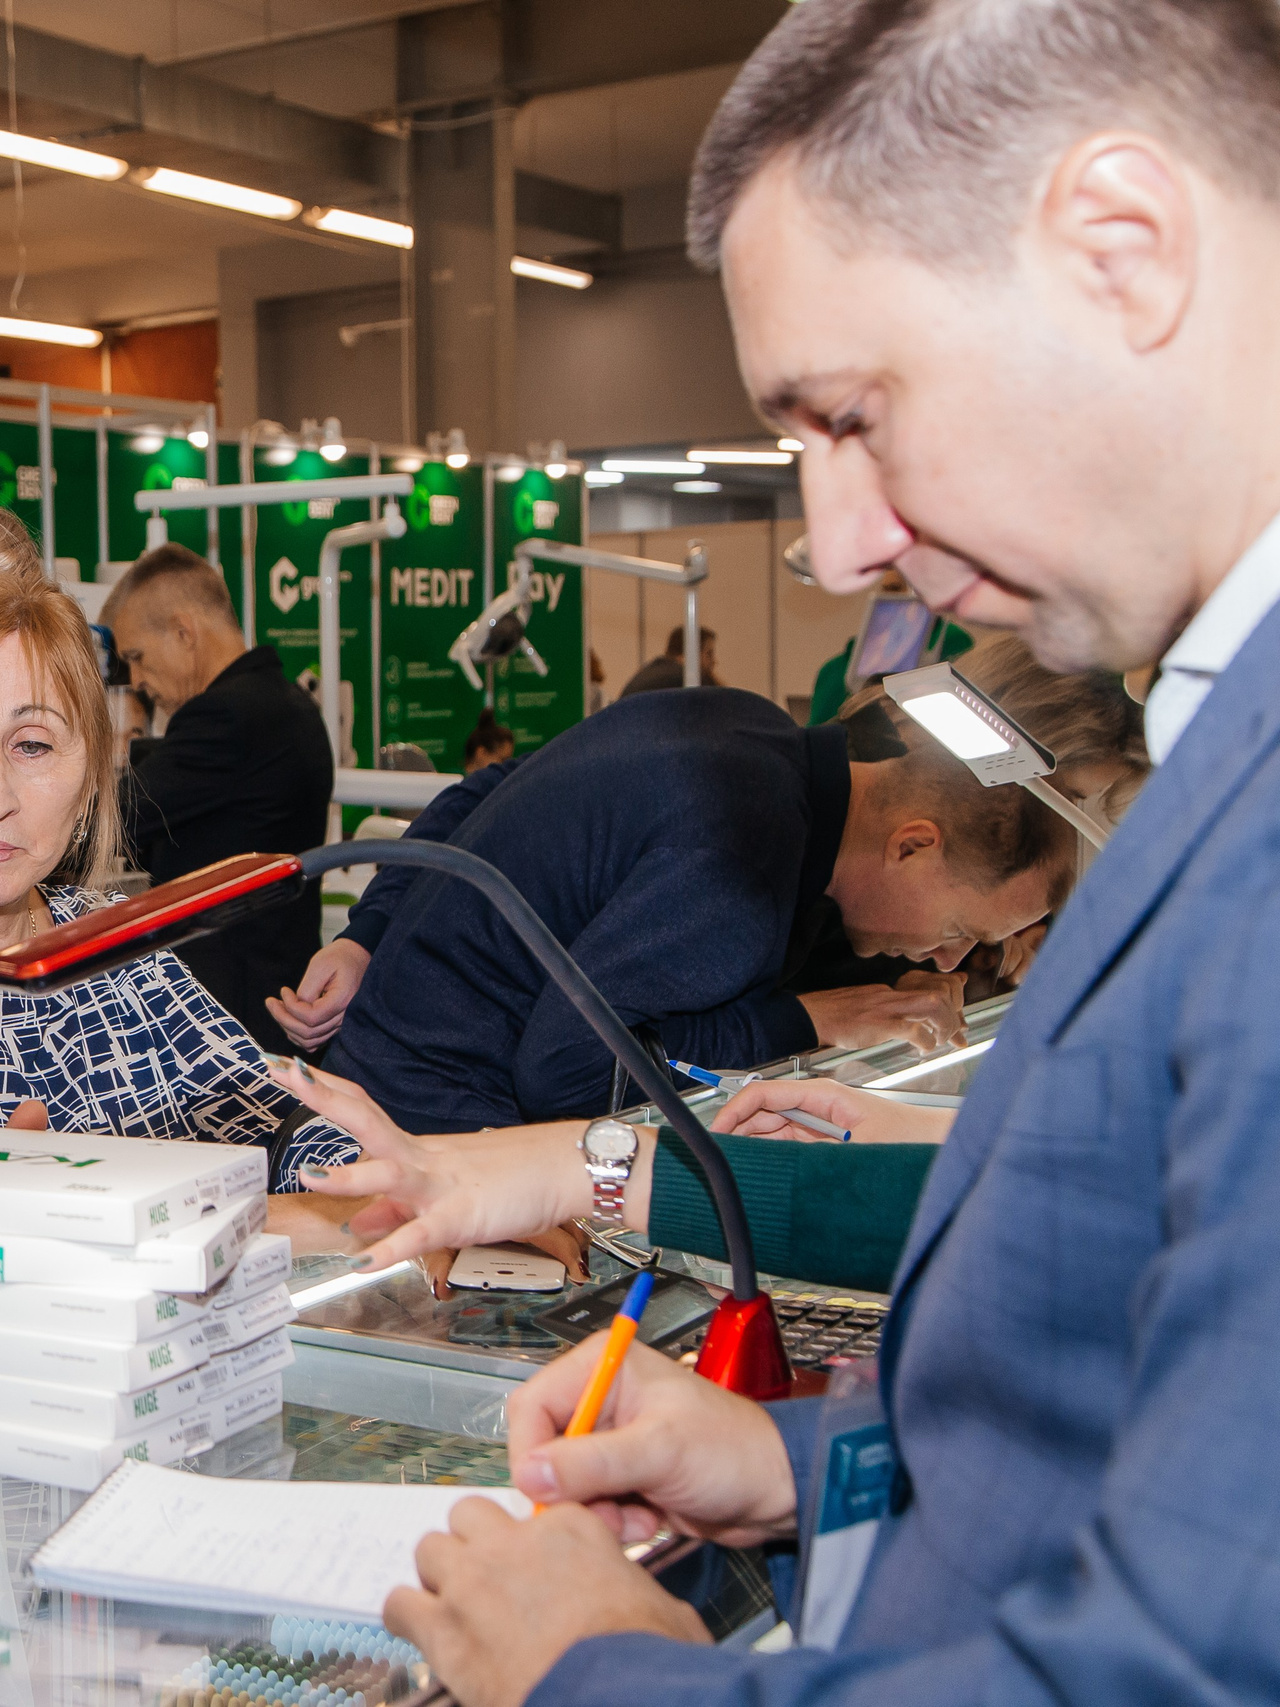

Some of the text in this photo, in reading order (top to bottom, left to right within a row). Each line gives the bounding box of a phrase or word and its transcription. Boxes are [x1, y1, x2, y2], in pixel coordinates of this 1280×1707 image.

[390, 566, 474, 607] MEDIT
[149, 1201, 171, 1227] HUGE
[156, 1295, 179, 1322] HUGE
[148, 1342, 174, 1371] HUGE
[133, 1388, 160, 1419] HUGE
